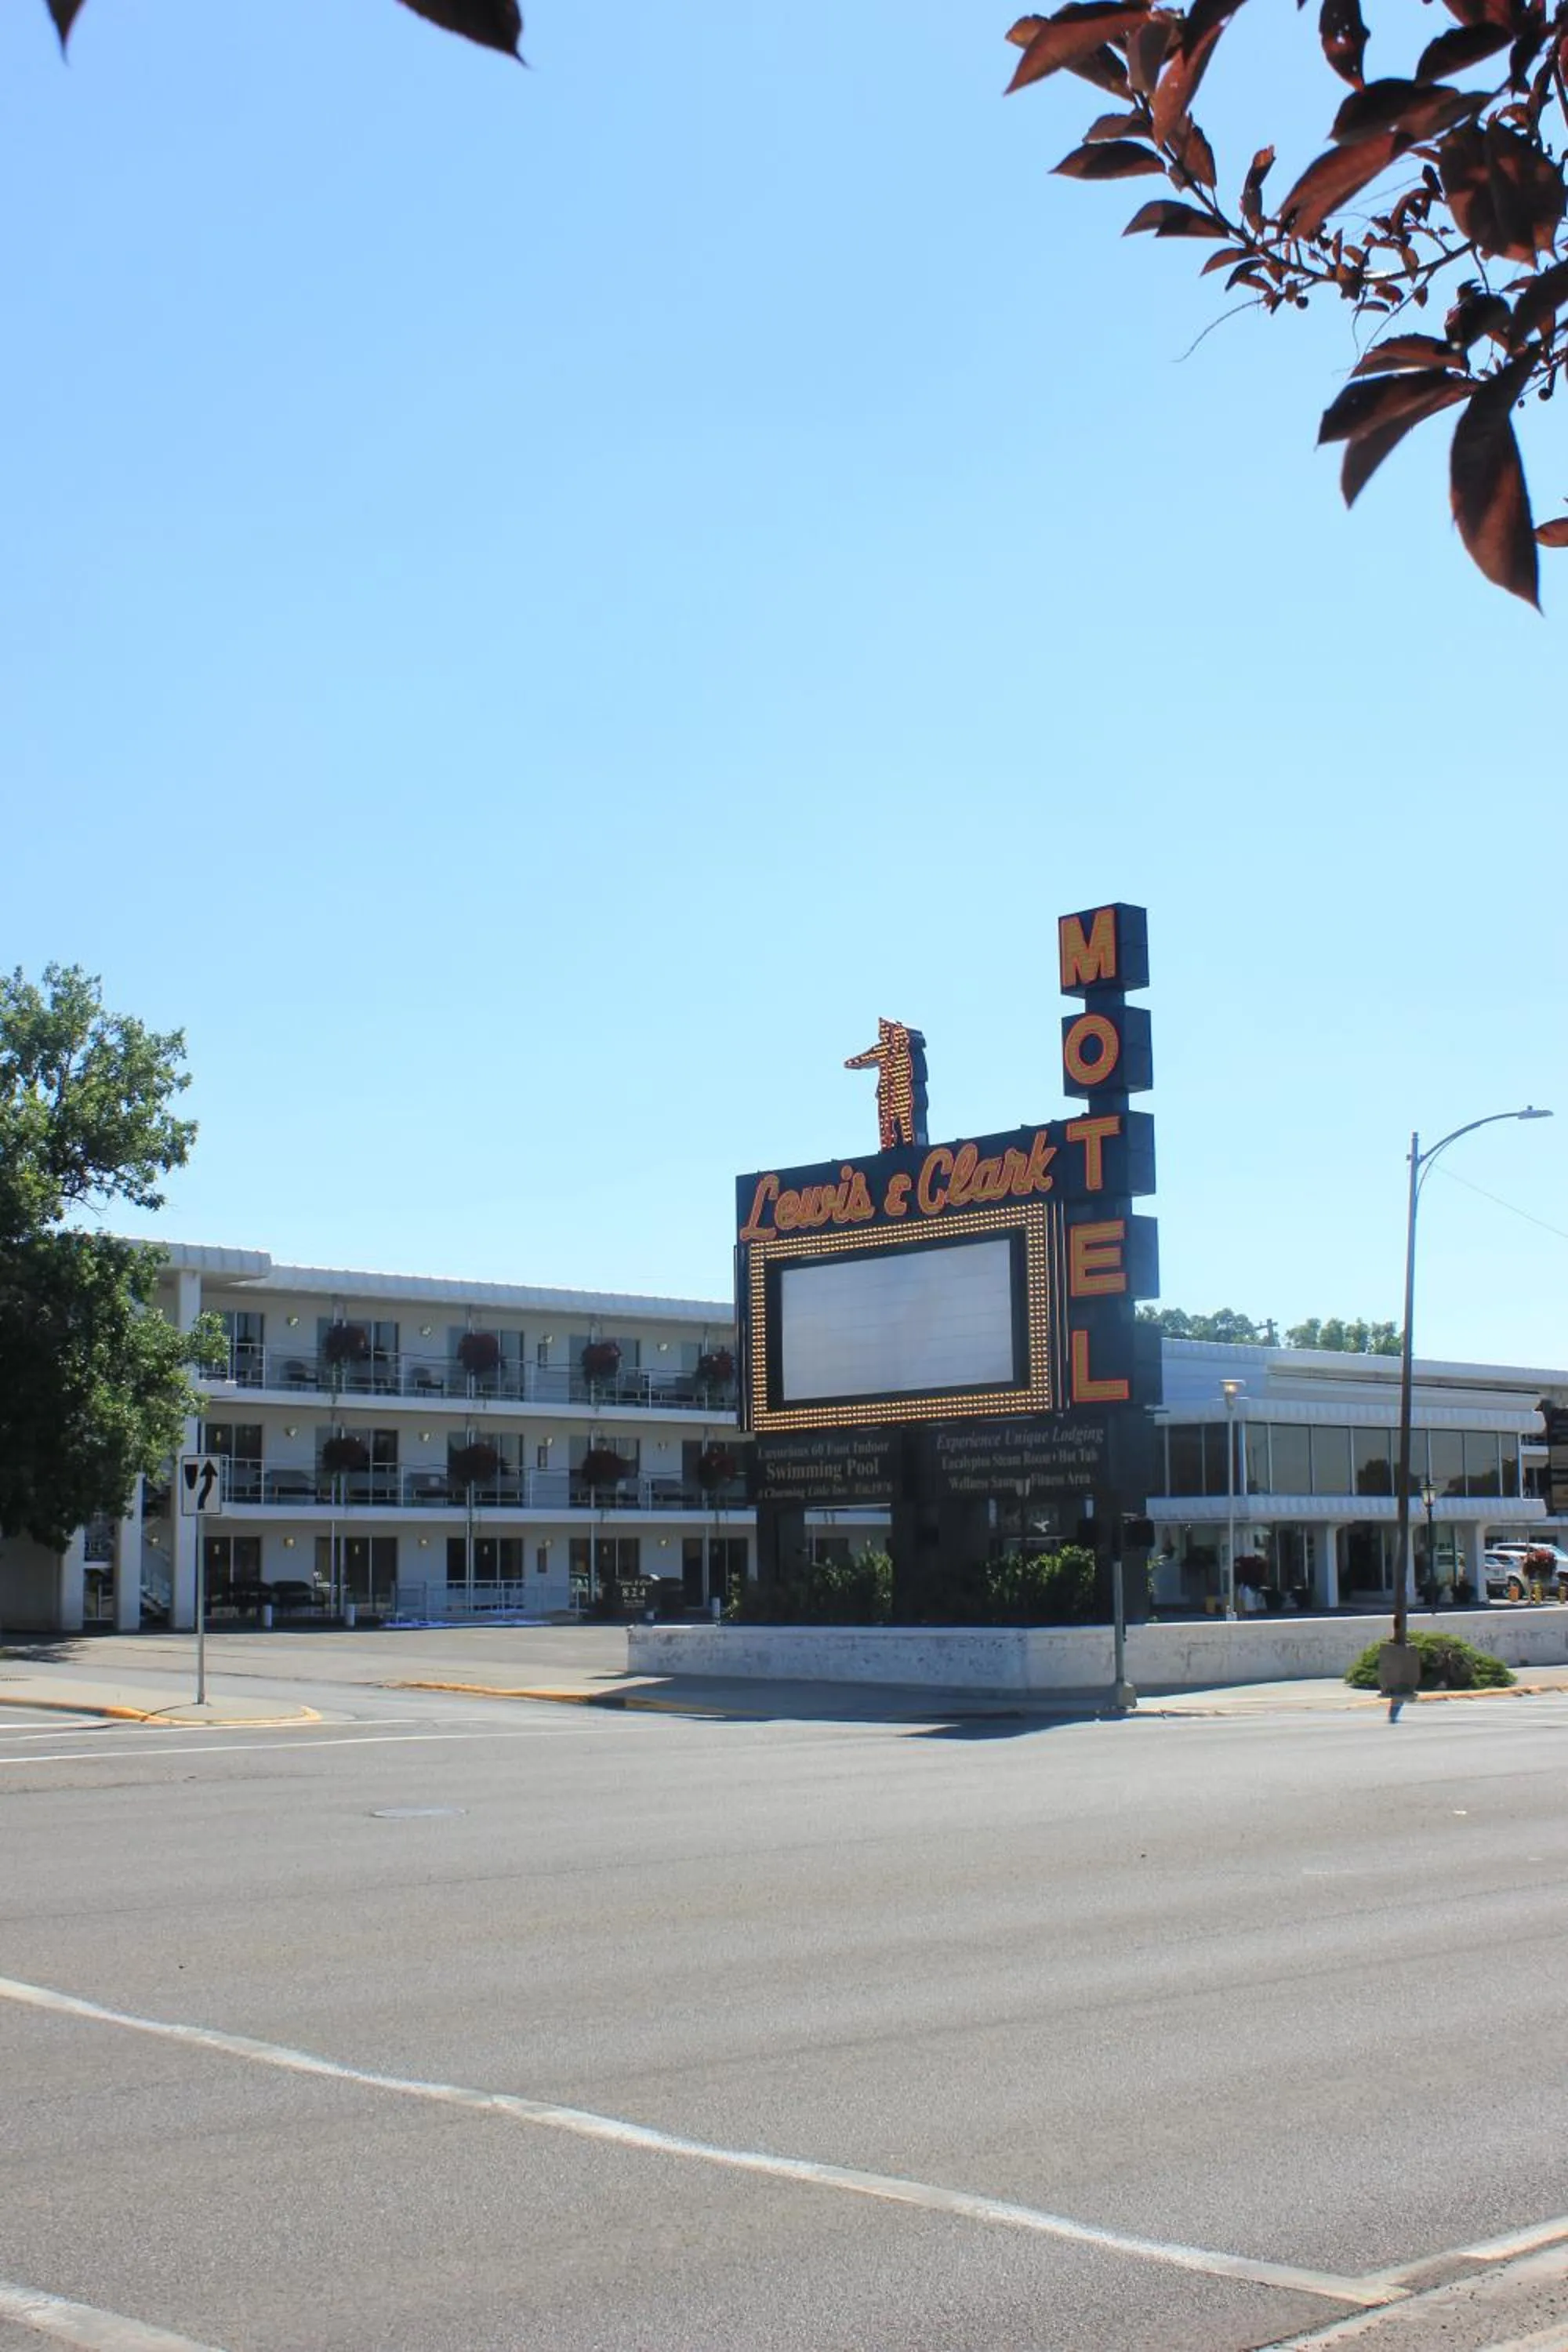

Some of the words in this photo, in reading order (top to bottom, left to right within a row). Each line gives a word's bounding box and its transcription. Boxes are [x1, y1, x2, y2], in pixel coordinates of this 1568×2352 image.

[1062, 907, 1130, 1403] MOTEL
[740, 1165, 875, 1241] Lewis
[918, 1129, 1058, 1216] Clark
[757, 1444, 808, 1459] Luxurious
[811, 1442, 824, 1456] 60
[826, 1440, 850, 1456] Foot
[854, 1439, 890, 1455] Indoor
[937, 1431, 1001, 1453] Experience
[1005, 1429, 1048, 1447] Unique
[1052, 1425, 1104, 1445] Lodging
[766, 1458, 842, 1481] Swimming
[847, 1457, 879, 1476] Pool
[942, 1455, 990, 1472] Eucalyptus
[993, 1453, 1021, 1467] Steam
[1023, 1450, 1051, 1465] Room
[1058, 1448, 1076, 1463] Hot
[1079, 1446, 1098, 1462] Tub
[991, 1475, 1017, 1489] Saun
[1067, 1471, 1091, 1485] Area
